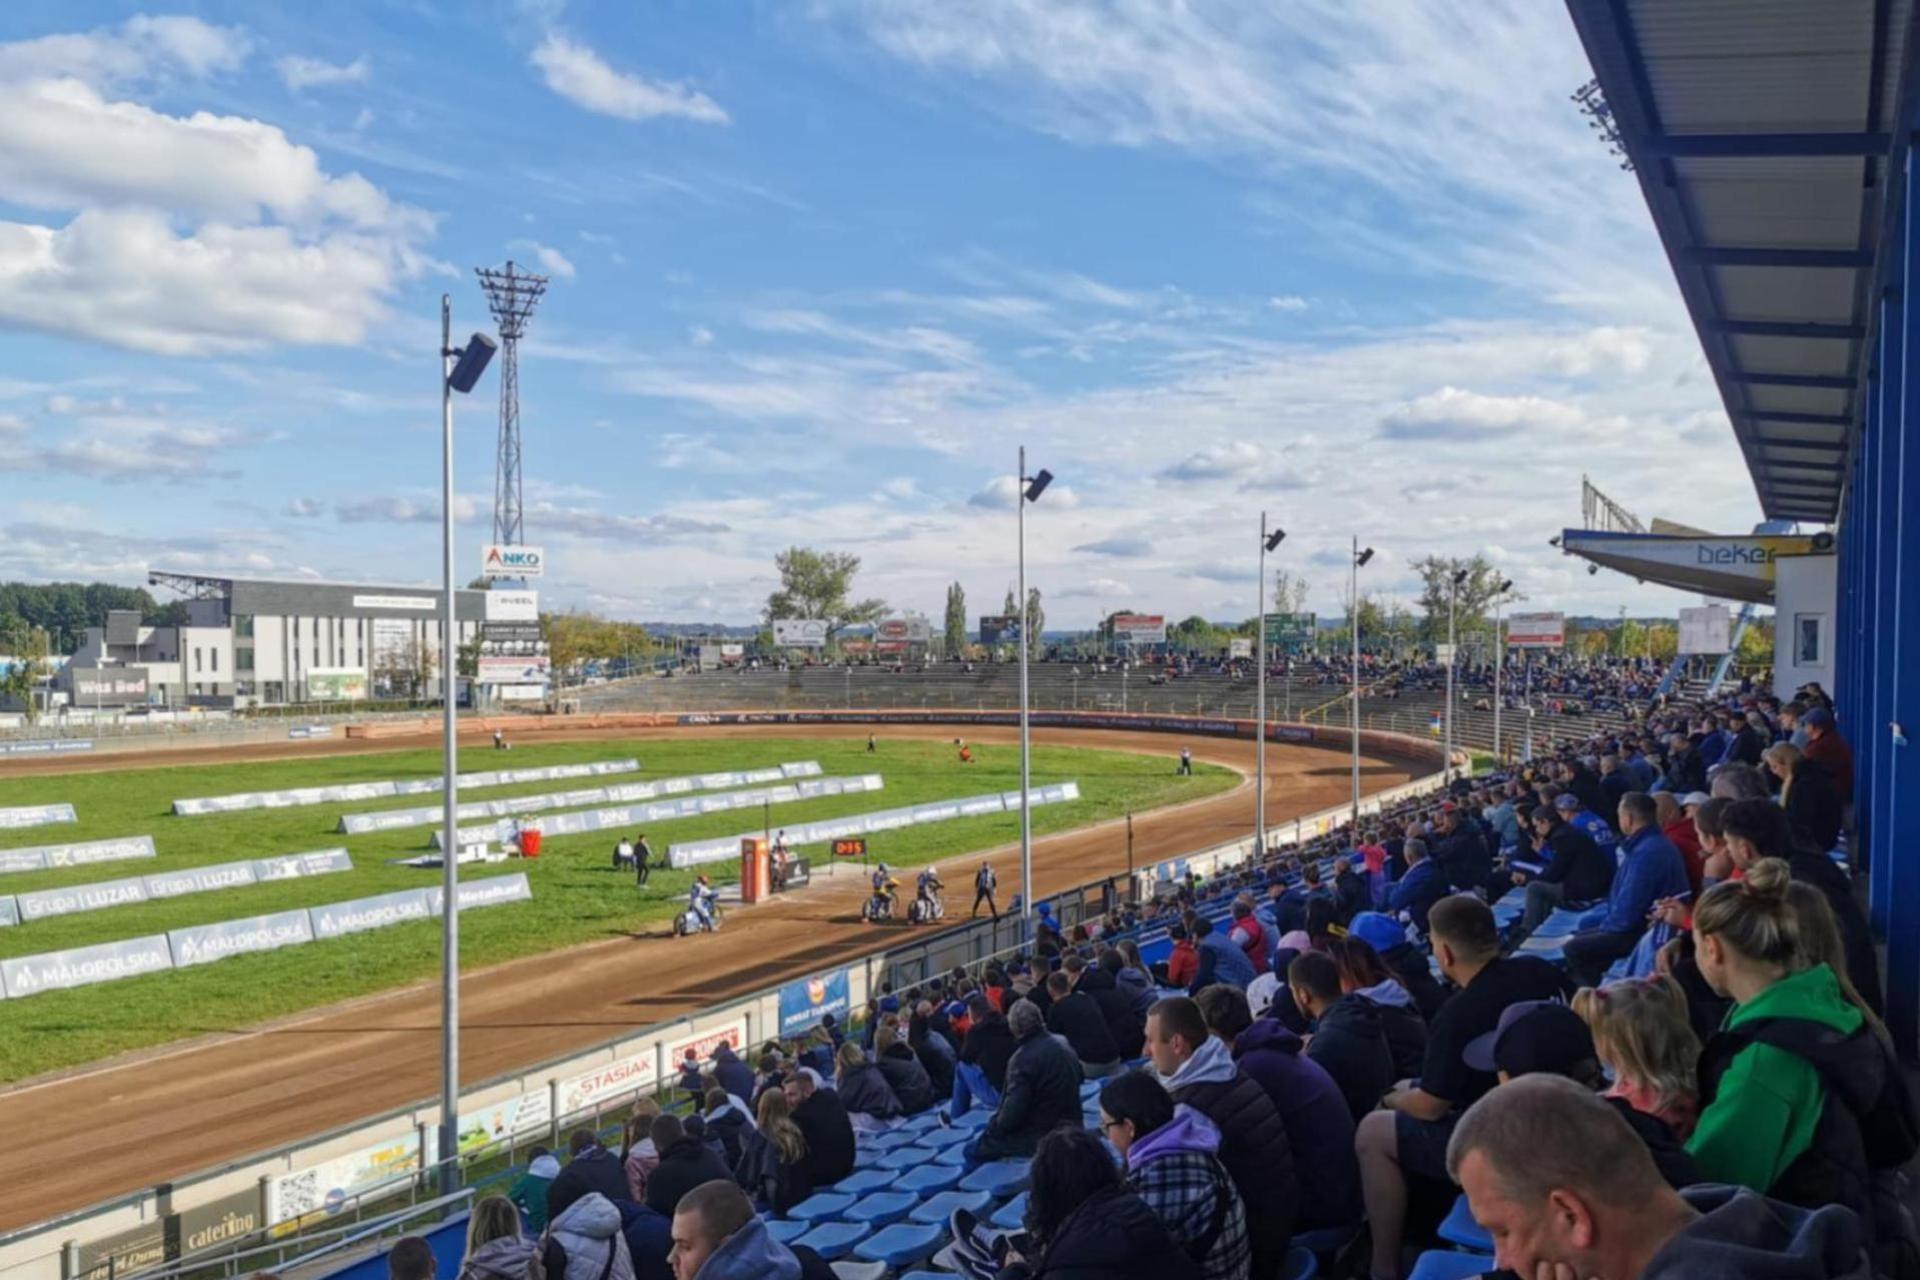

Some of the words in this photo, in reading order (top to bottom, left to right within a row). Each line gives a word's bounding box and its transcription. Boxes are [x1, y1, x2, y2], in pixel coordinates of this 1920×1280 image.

[487, 548, 540, 566] ANKO
[151, 876, 195, 896] Grupa
[202, 869, 251, 888] LUZAR
[26, 891, 77, 916] Grupa
[85, 885, 140, 907] LUZAR
[202, 922, 304, 952] MAŁOPOLSKA
[42, 951, 163, 984] MAŁOPOLSKA
[581, 1058, 651, 1093] STASIAK
[188, 1212, 254, 1249] catering
